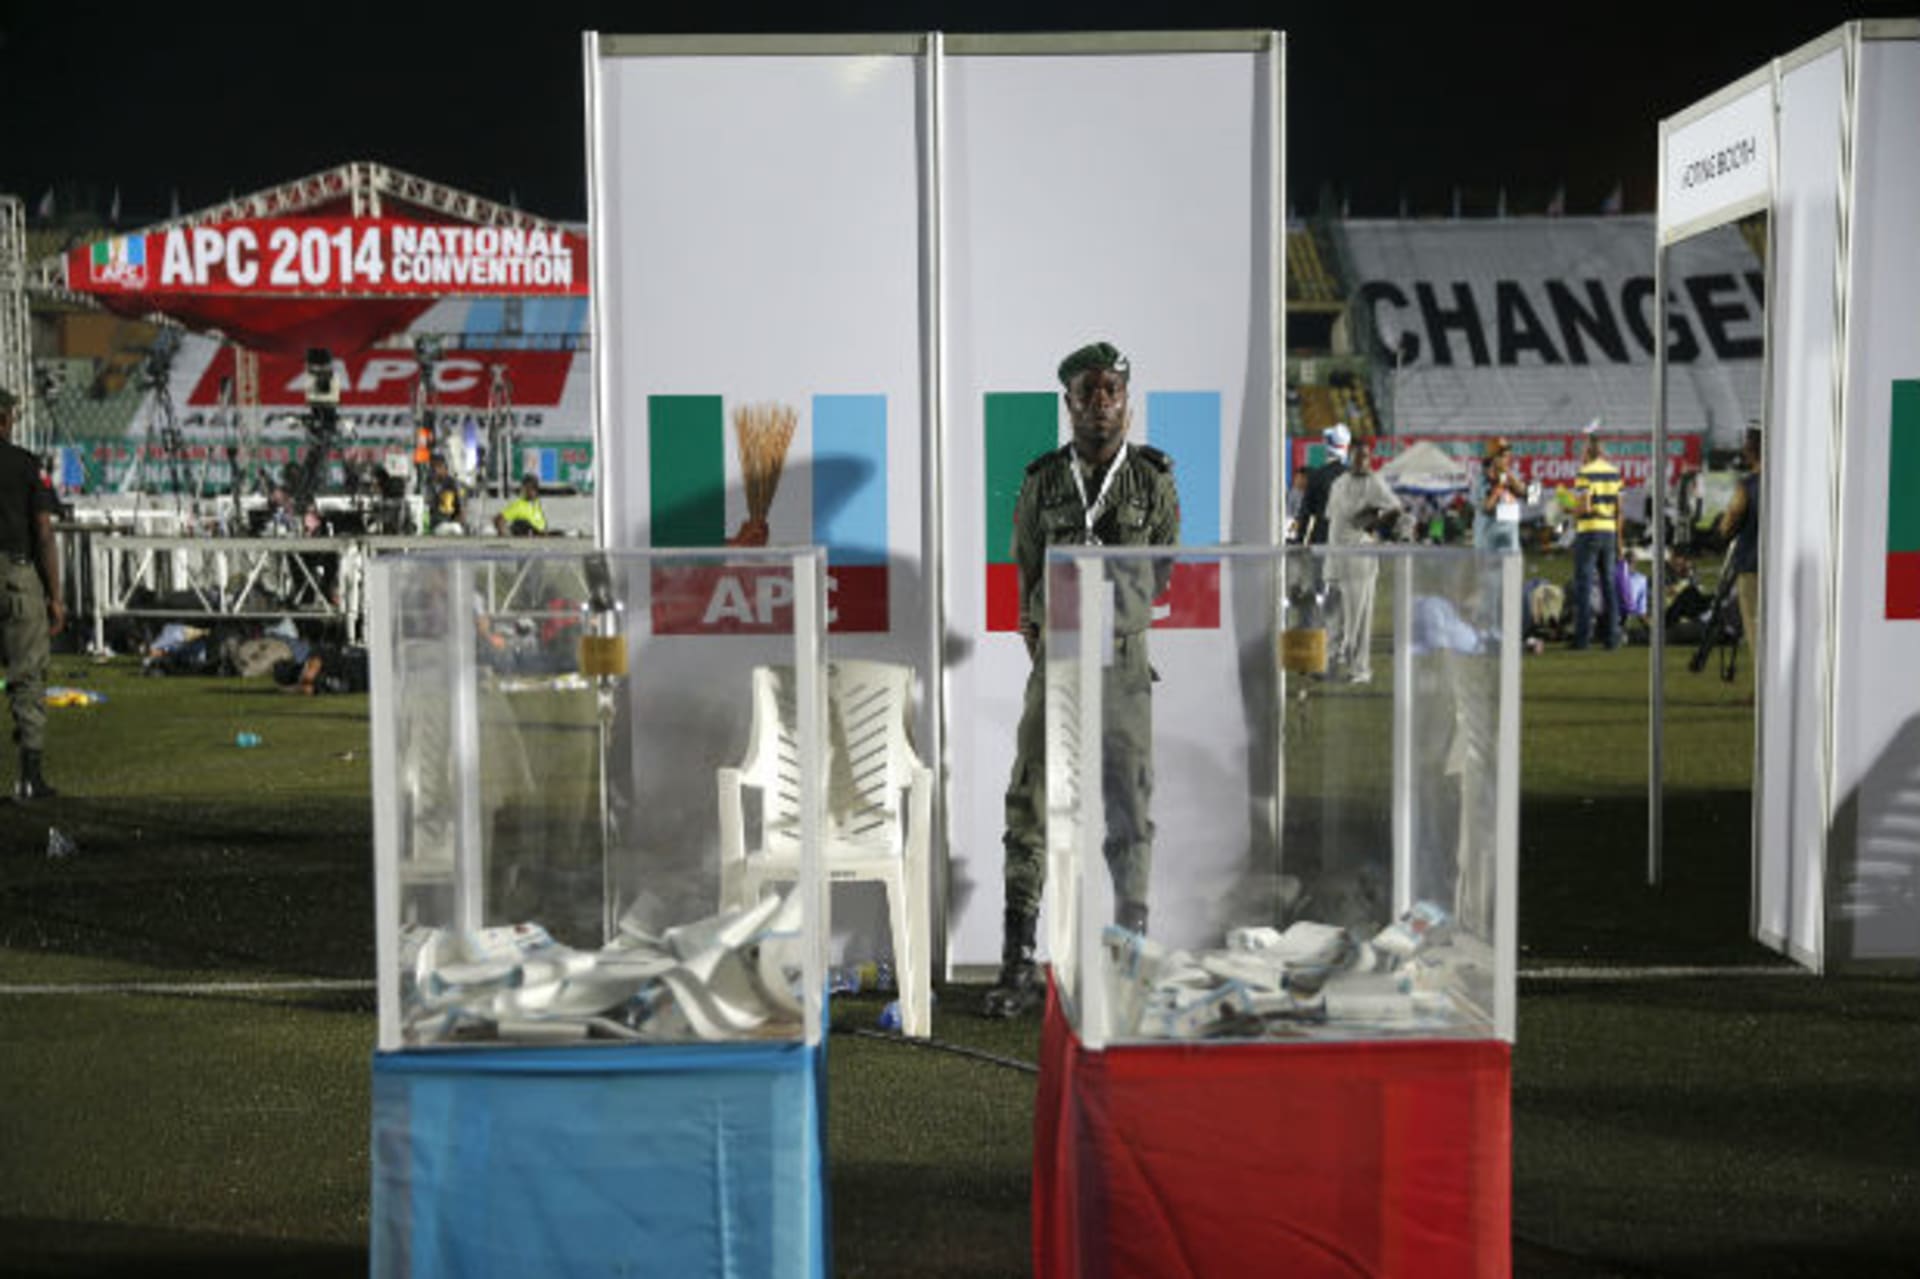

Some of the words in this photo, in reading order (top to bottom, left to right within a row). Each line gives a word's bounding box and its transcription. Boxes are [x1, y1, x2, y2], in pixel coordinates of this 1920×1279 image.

[160, 227, 260, 286] APC
[269, 226, 385, 286] 2014
[391, 225, 572, 256] NATIONAL
[391, 254, 573, 286] CONVENTION
[284, 358, 485, 393] APC
